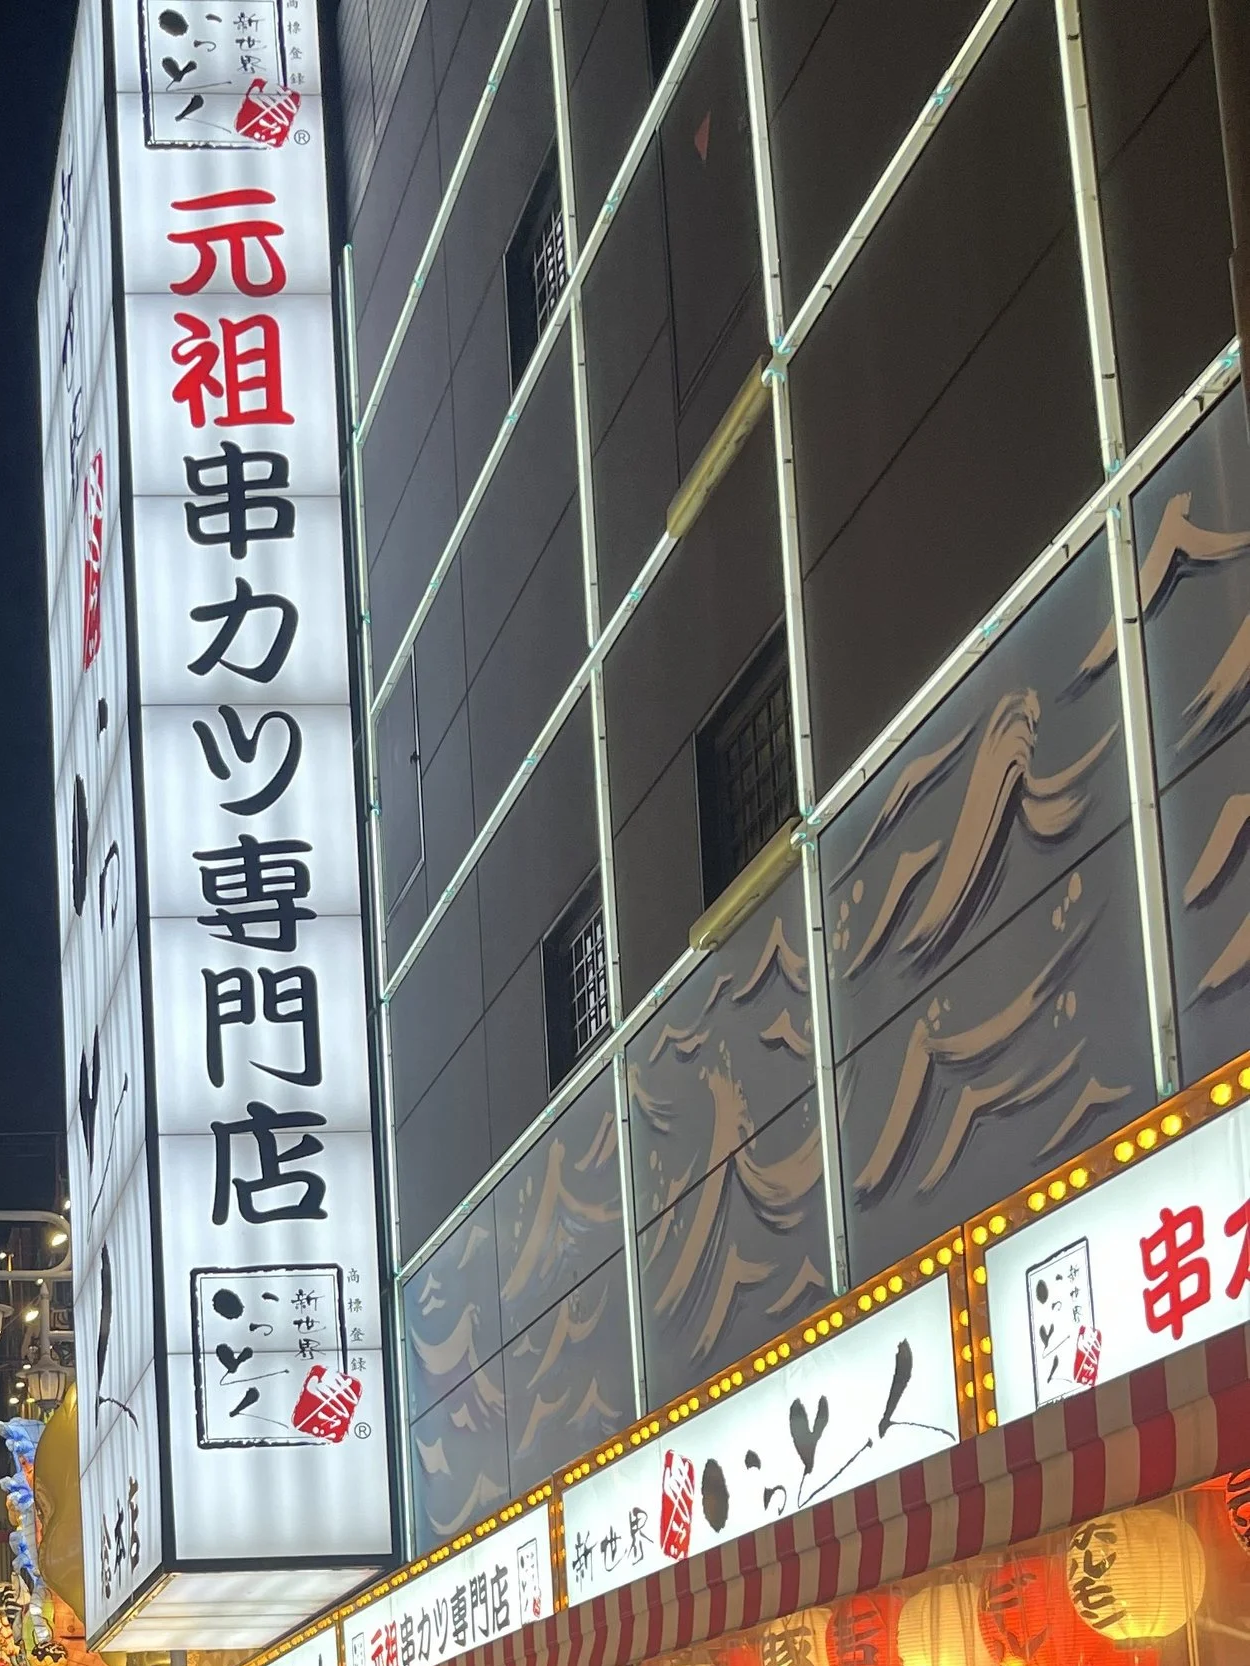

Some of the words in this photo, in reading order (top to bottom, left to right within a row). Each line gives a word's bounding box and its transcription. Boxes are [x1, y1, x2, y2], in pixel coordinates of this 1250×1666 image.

[166, 188, 329, 1226] 元祖串カツ専門店
[291, 1289, 327, 1361] 新世界
[346, 1268, 366, 1371] 商標登録
[571, 1506, 654, 1592] 新世界
